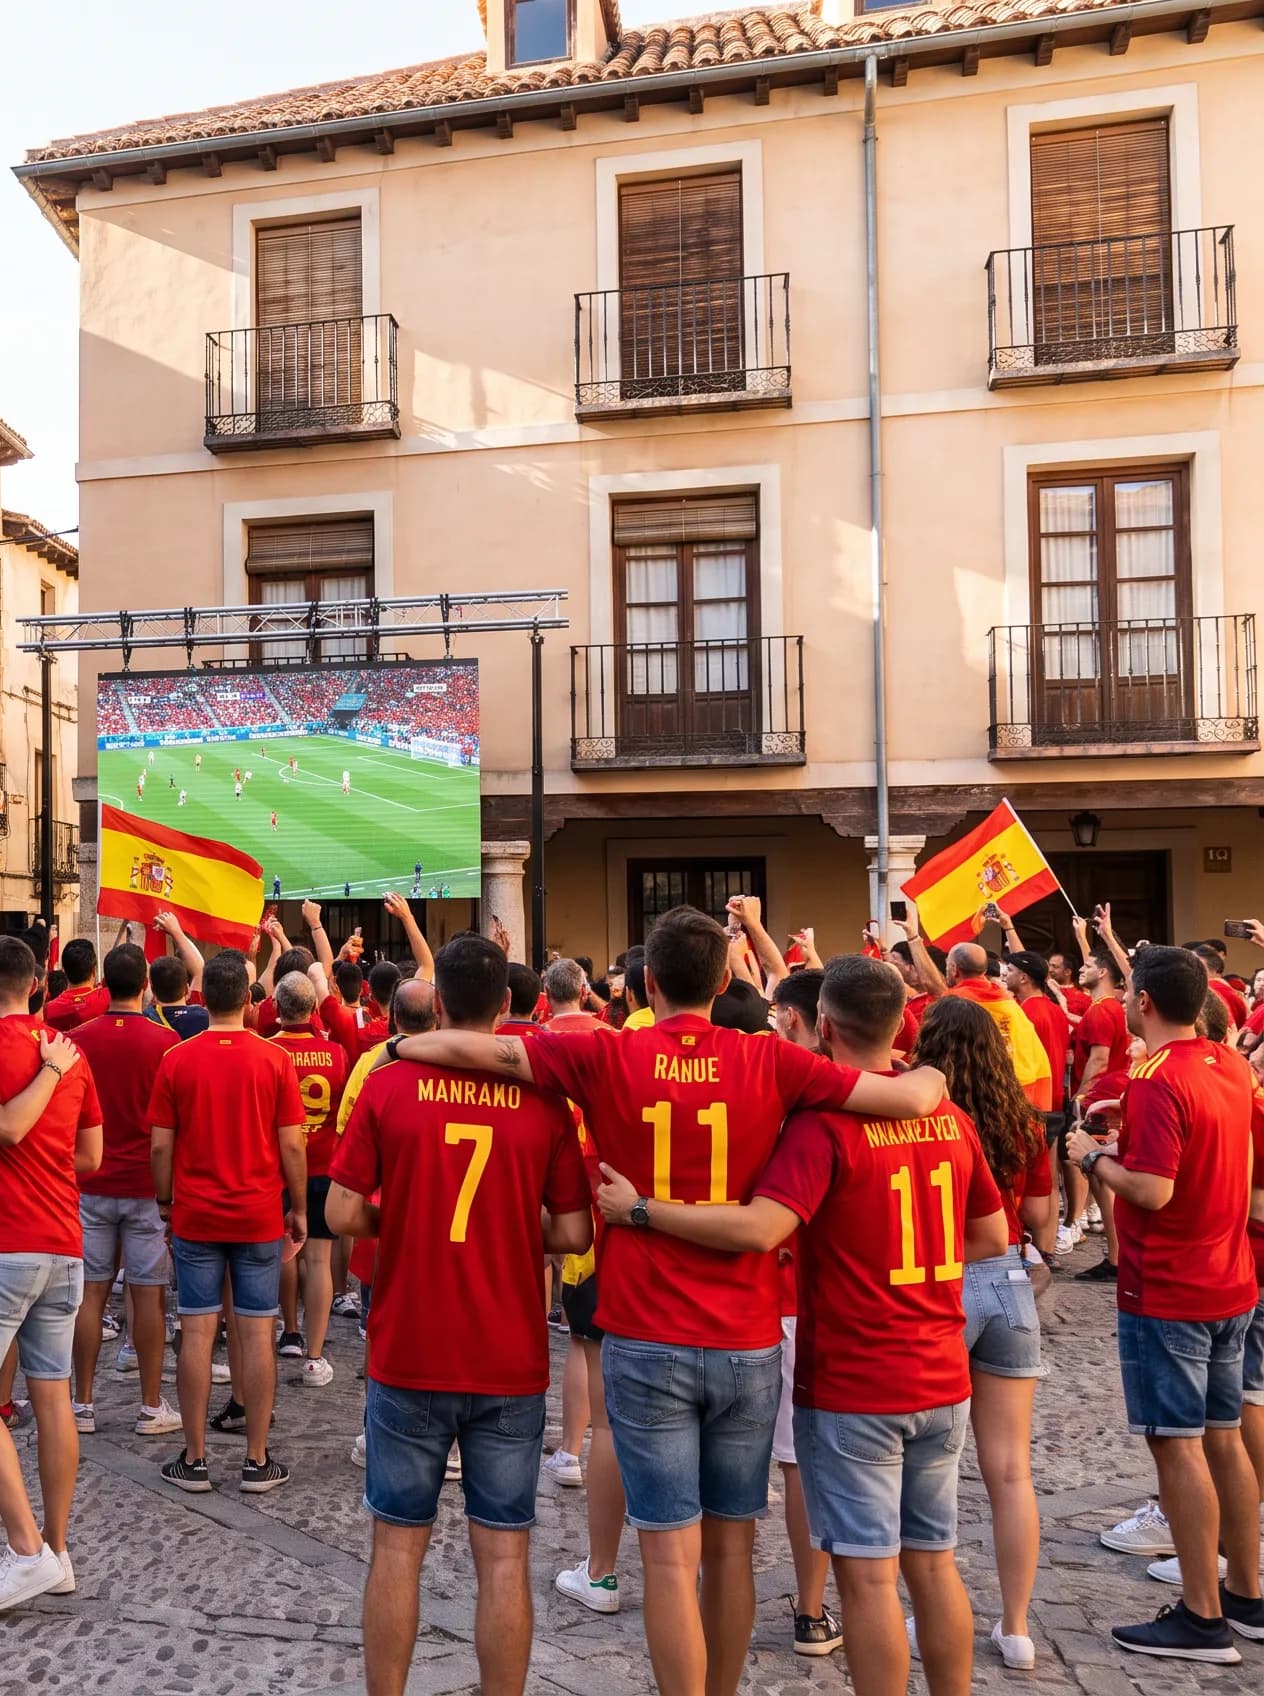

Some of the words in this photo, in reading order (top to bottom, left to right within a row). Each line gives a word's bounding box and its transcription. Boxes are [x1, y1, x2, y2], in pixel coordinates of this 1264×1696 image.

[300, 1074, 331, 1125] 9
[642, 1101, 740, 1206] 11
[444, 1122, 493, 1243] 7
[889, 1161, 963, 1286] 11
